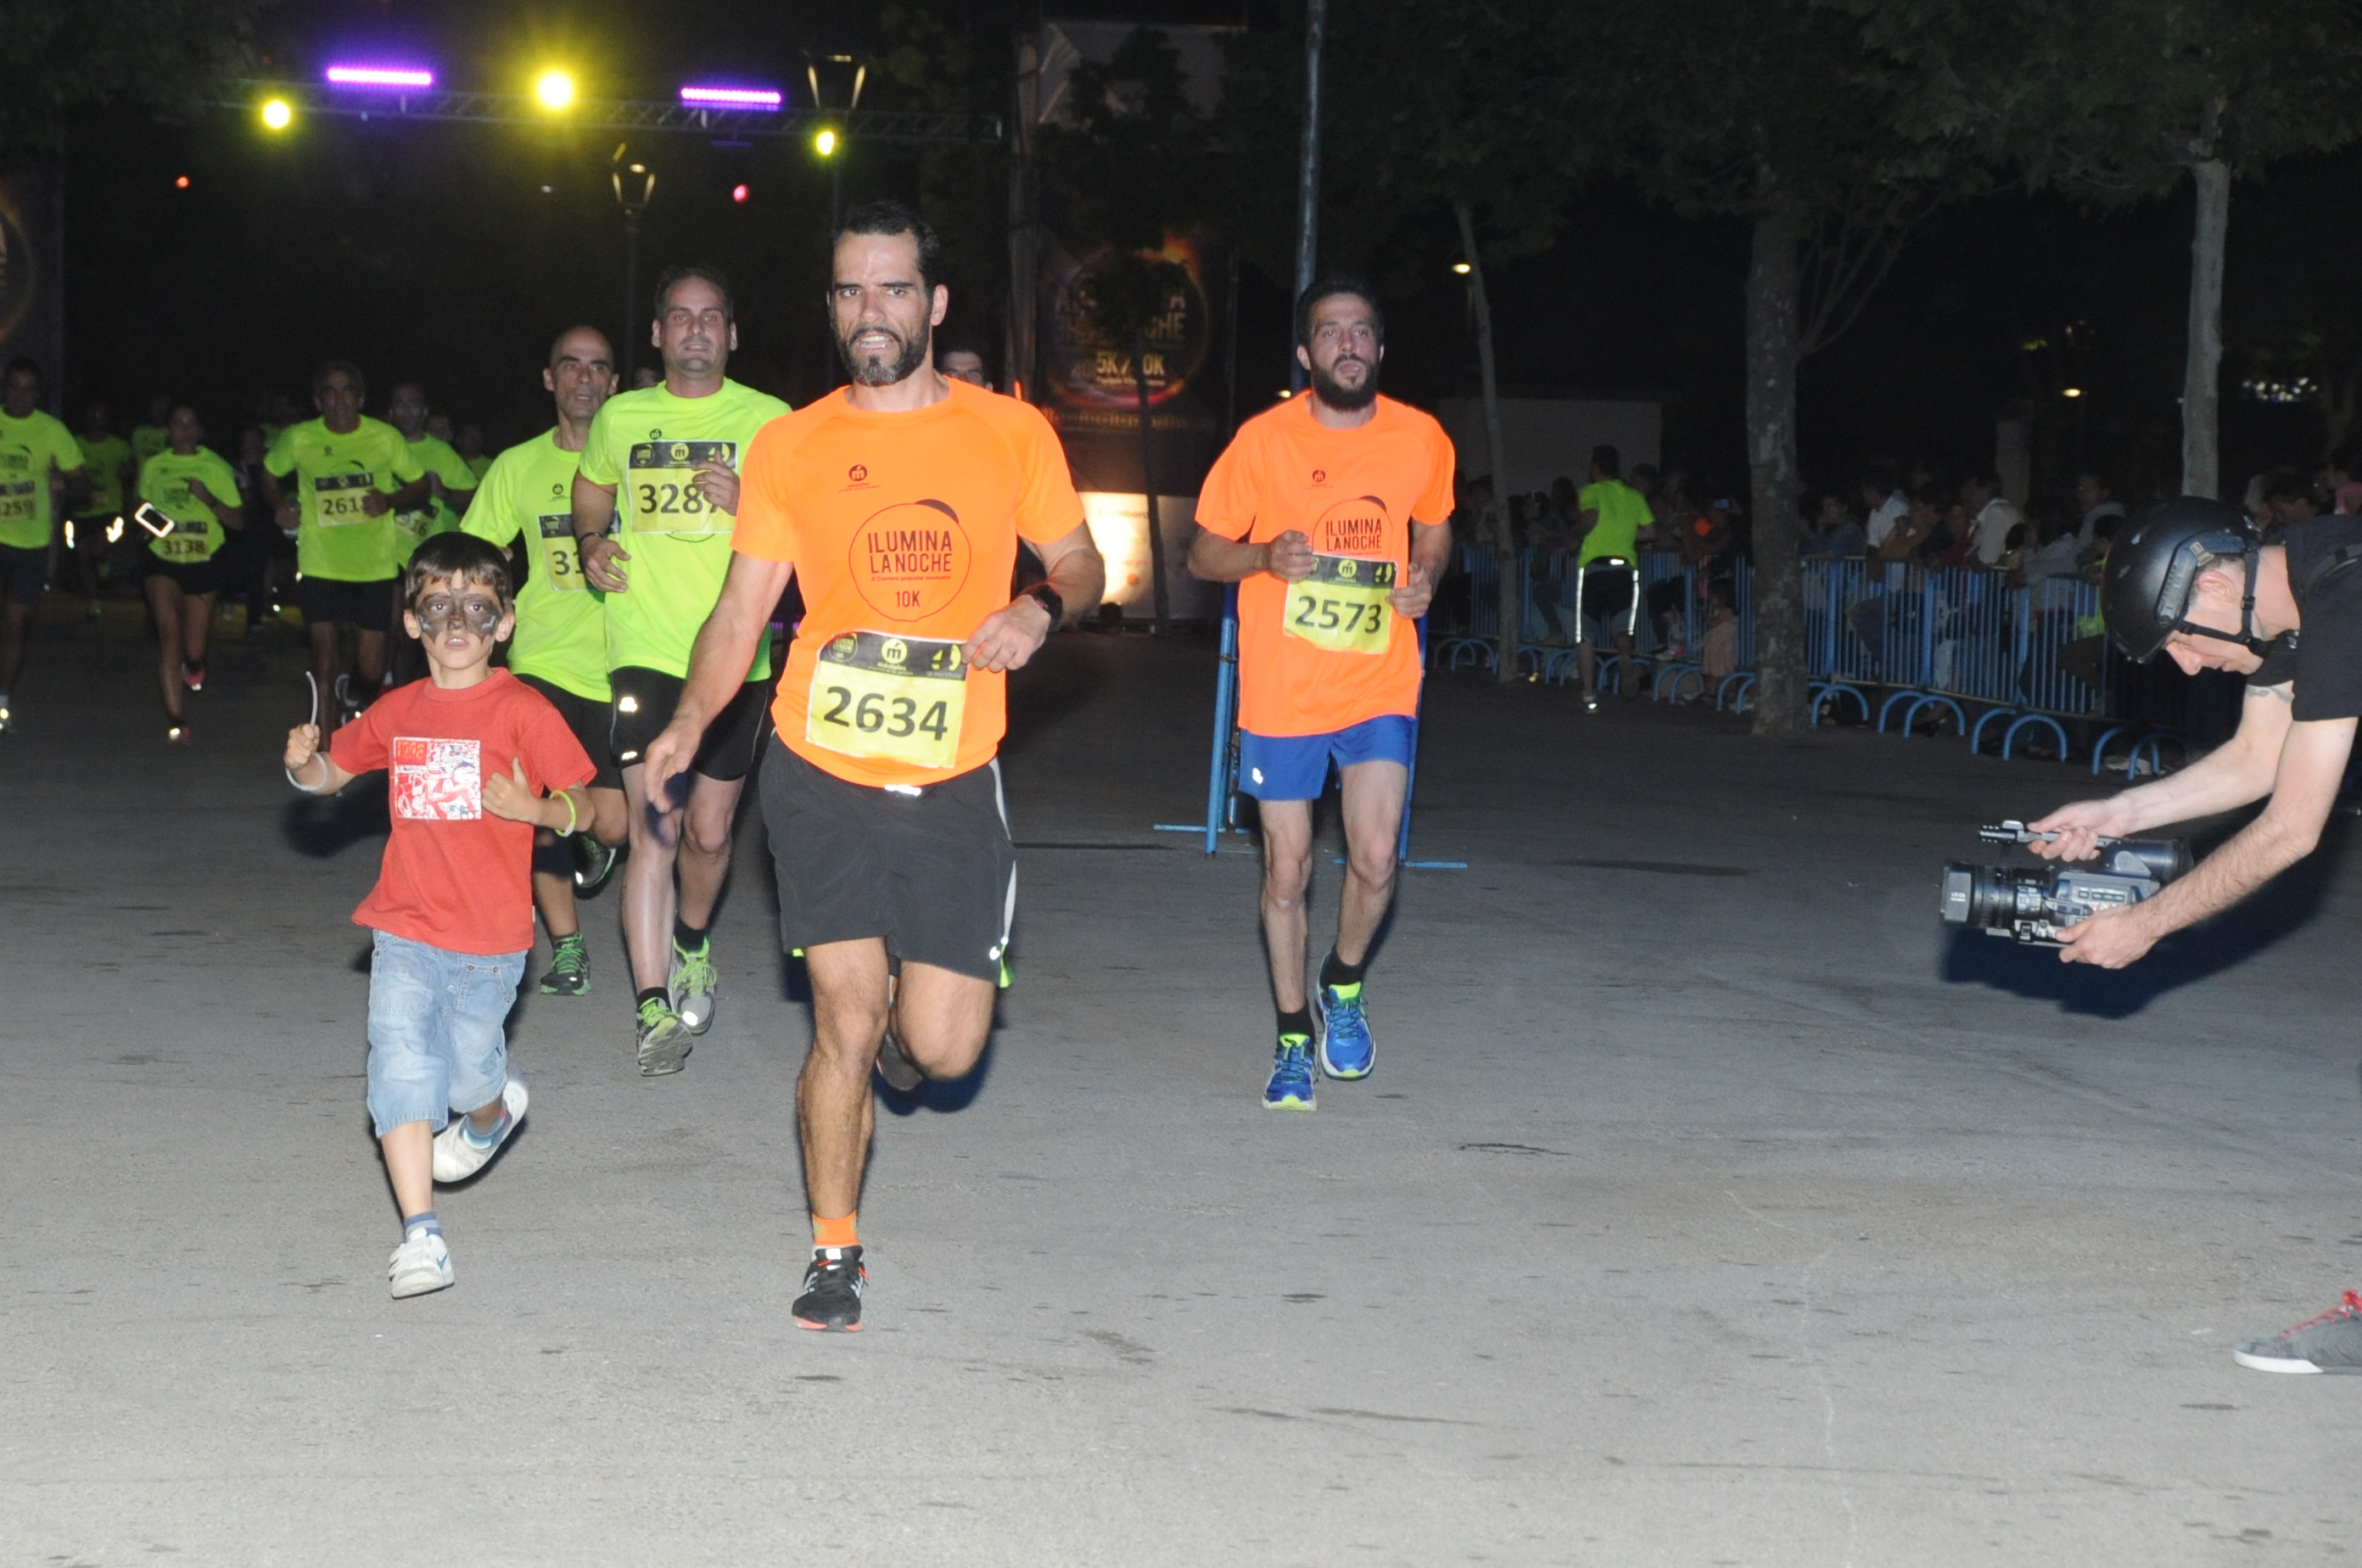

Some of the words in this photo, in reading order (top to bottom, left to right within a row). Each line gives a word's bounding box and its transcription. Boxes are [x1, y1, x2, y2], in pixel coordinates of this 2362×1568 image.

[323, 497, 361, 515] 261
[639, 484, 719, 513] 328
[1325, 518, 1382, 537] ILUMINA
[868, 529, 953, 554] ILUMINA
[895, 590, 921, 608] 10K
[1295, 596, 1382, 635] 2573
[824, 686, 948, 741] 2634
